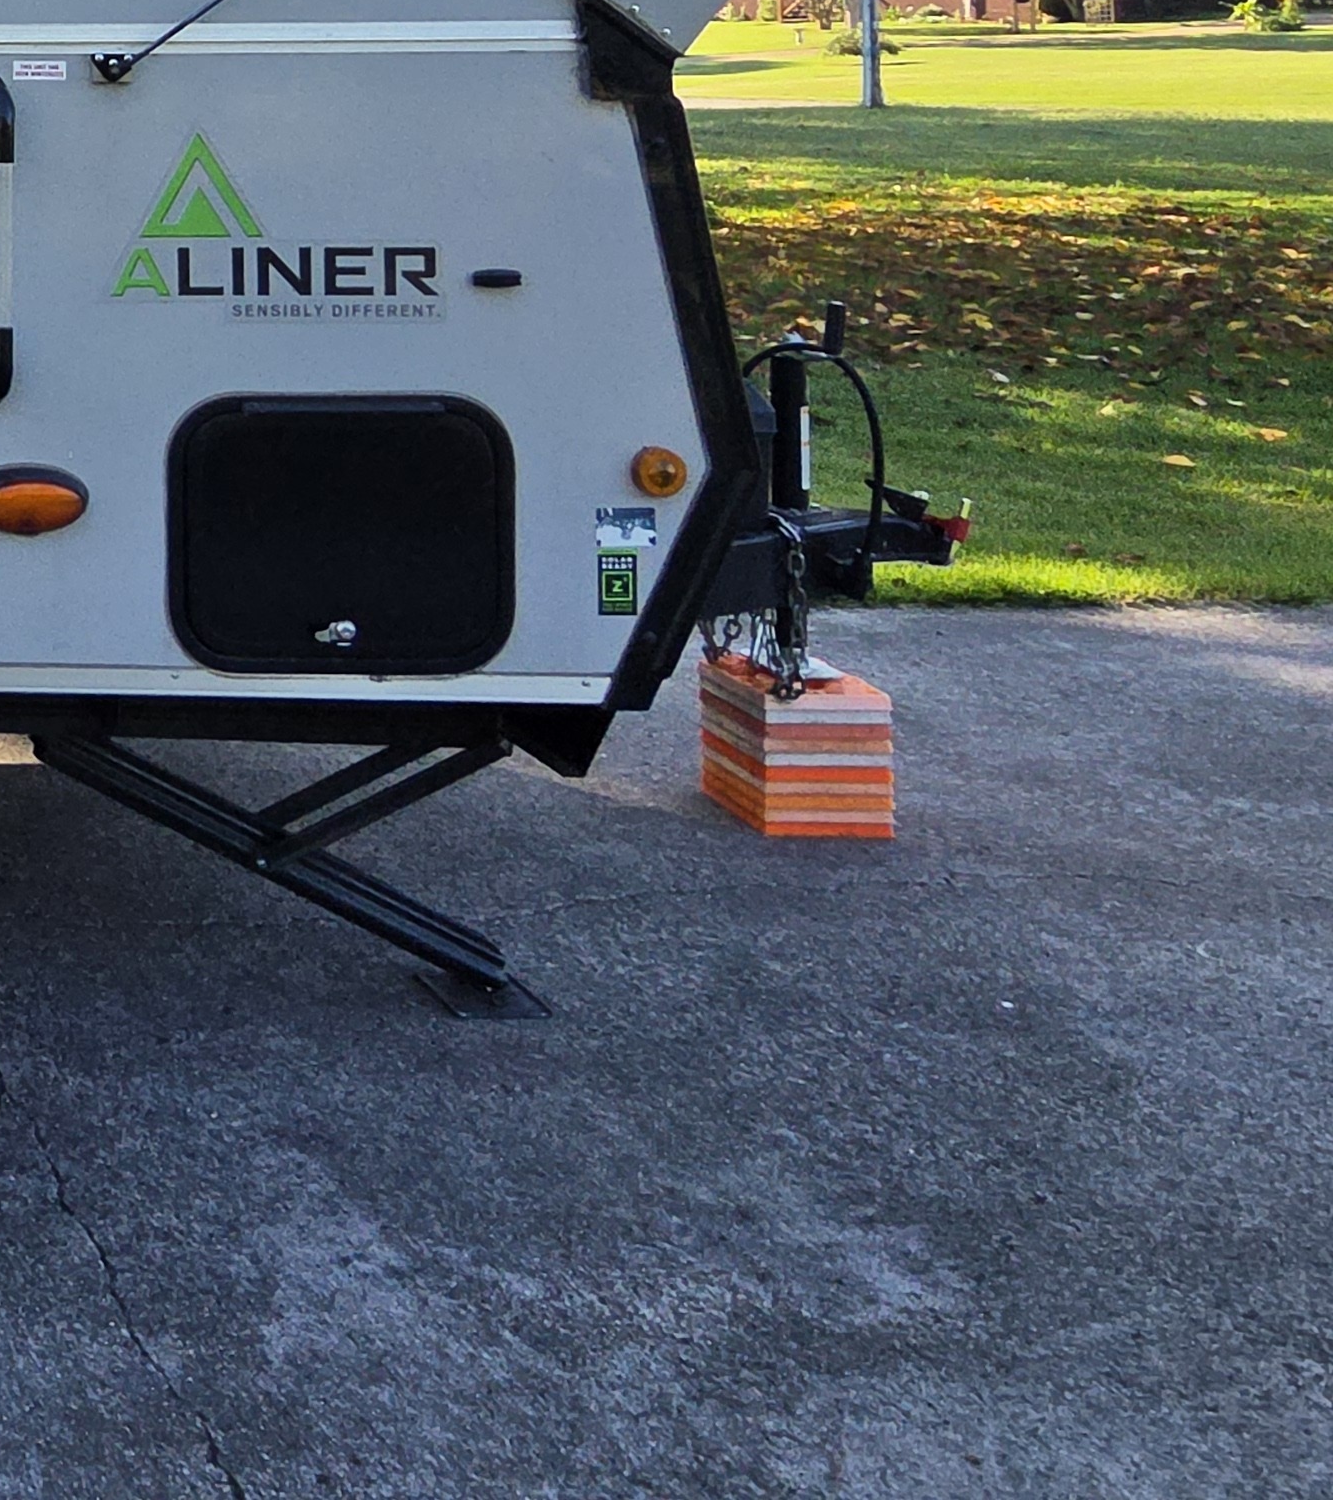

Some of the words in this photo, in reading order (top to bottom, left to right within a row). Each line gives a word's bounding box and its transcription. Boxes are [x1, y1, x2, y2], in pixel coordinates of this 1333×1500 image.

[109, 246, 440, 297] ALINER
[231, 303, 325, 318] SENSIBLY
[331, 303, 442, 318] DIFFERENT.
